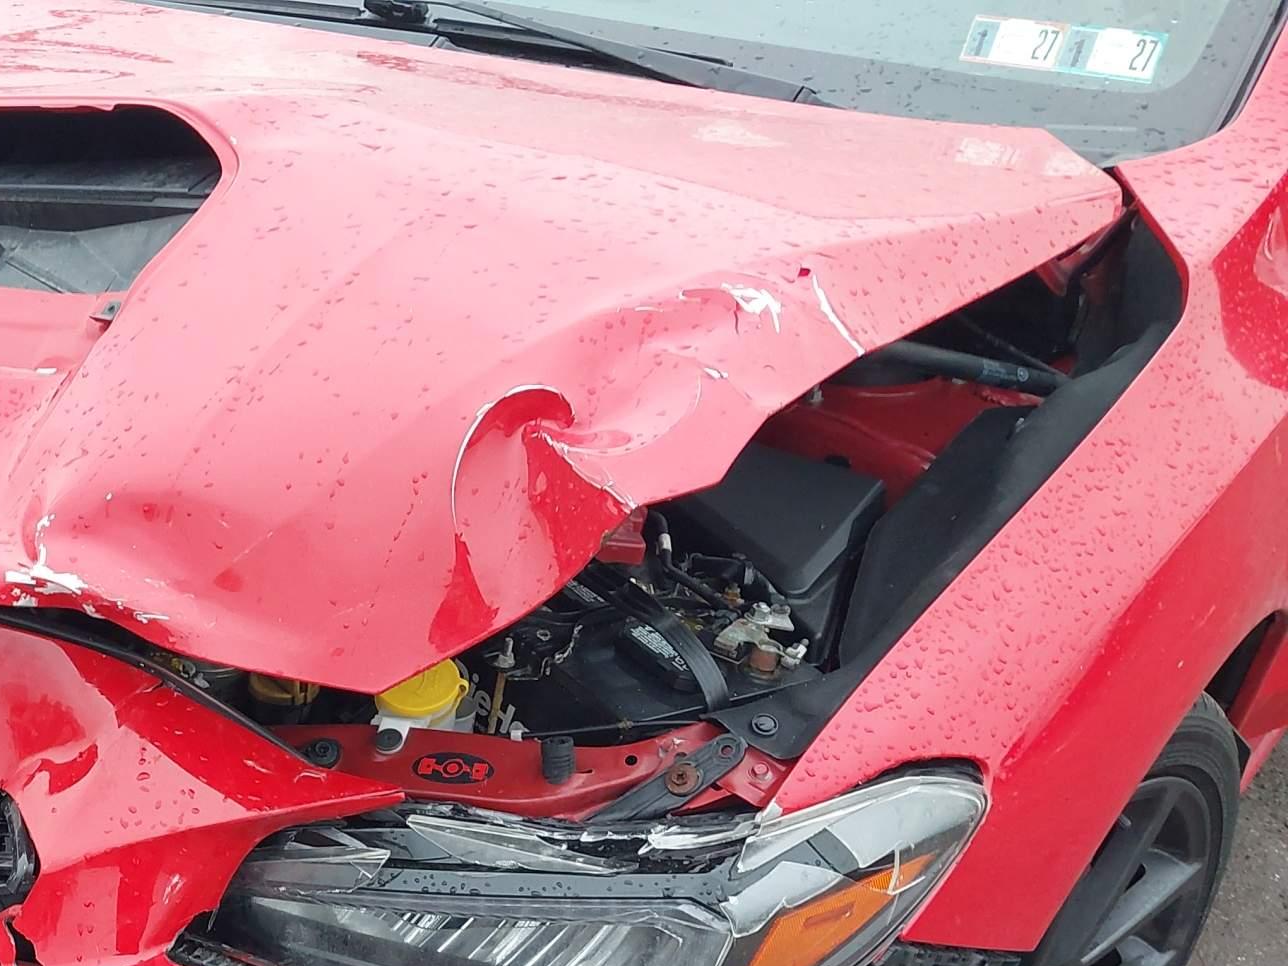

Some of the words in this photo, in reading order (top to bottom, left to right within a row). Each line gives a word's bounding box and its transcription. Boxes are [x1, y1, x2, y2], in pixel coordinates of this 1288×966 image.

[974, 29, 988, 56] 1
[1030, 29, 1060, 61] 27
[1069, 38, 1086, 67] 1
[1128, 38, 1159, 72] 27
